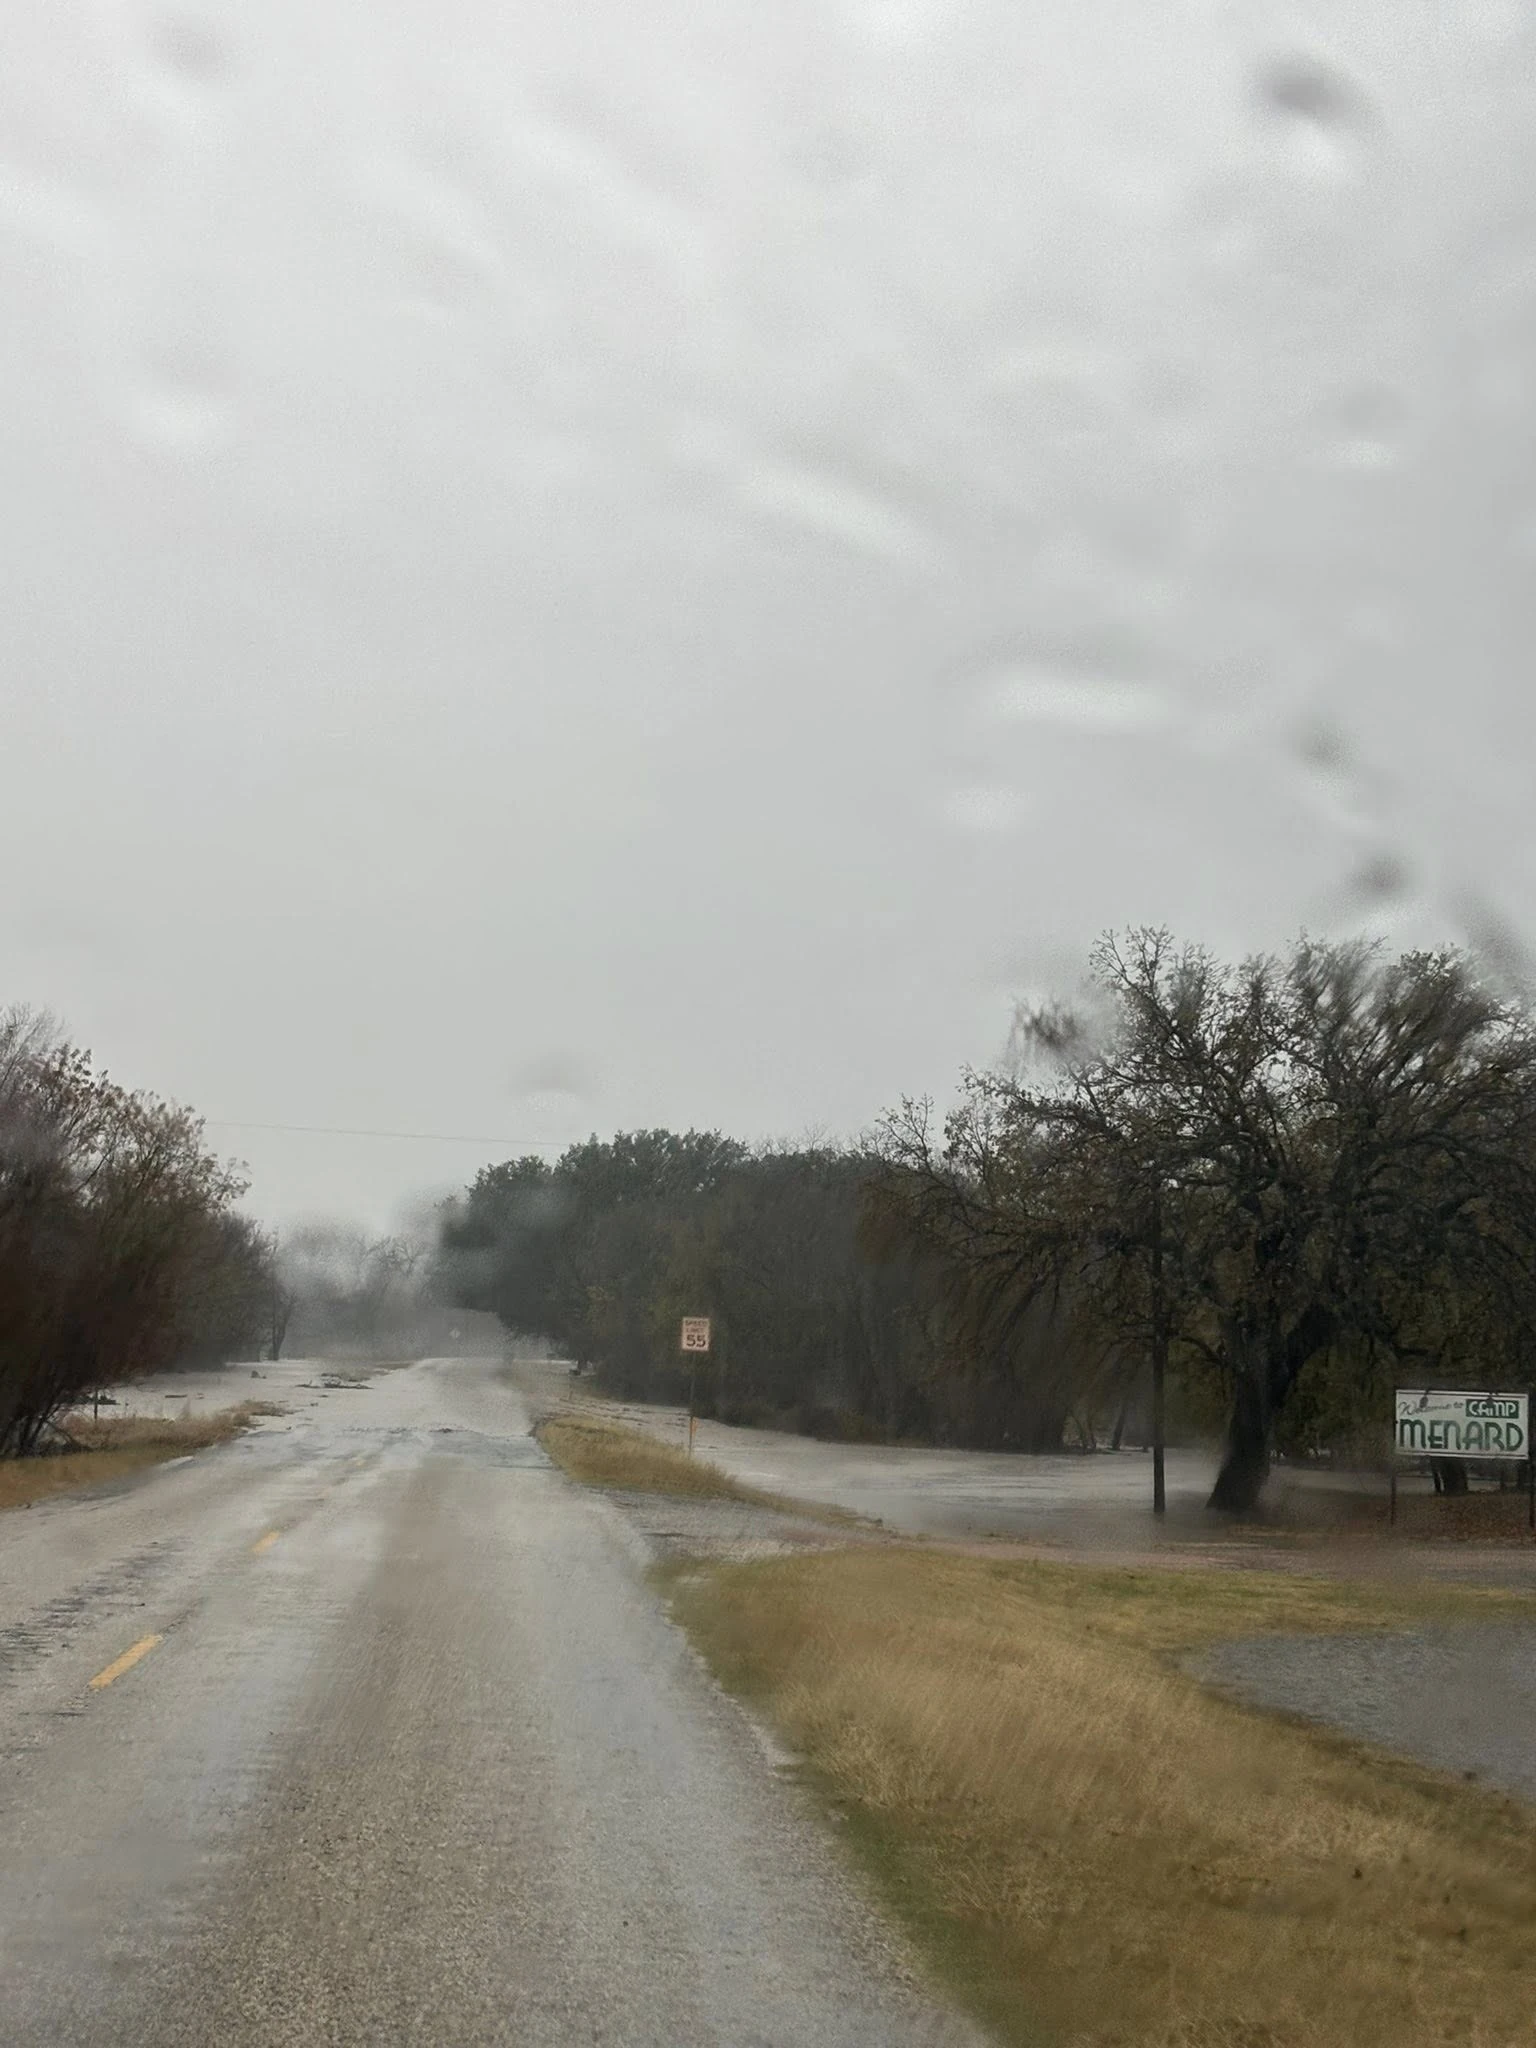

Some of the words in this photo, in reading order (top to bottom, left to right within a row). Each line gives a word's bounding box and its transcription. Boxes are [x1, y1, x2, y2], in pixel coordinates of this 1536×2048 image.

[686, 1334, 706, 1347] 55
[1398, 1400, 1452, 1416] Wecome
[1399, 1418, 1524, 1451] MENARD
